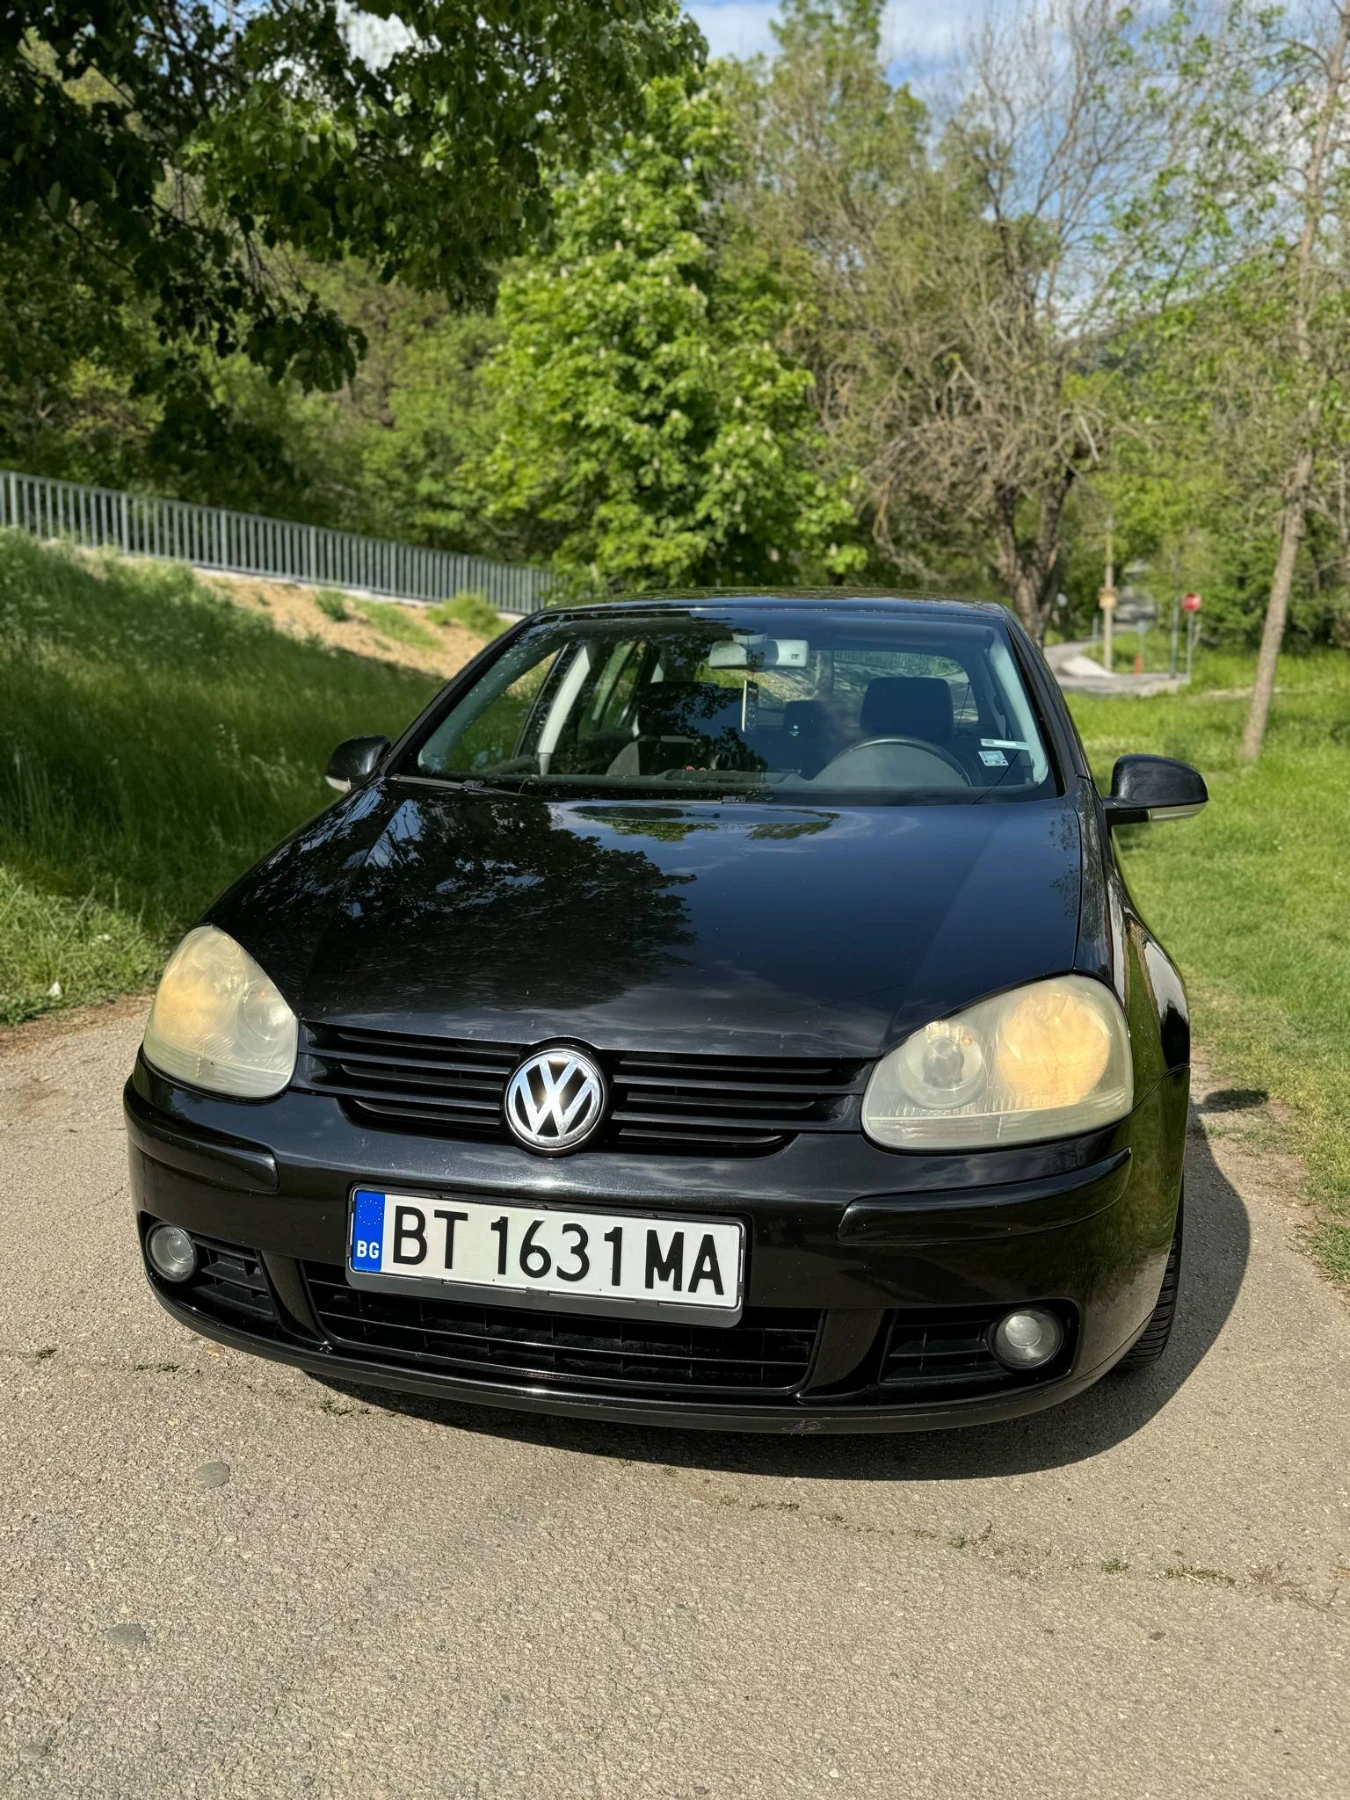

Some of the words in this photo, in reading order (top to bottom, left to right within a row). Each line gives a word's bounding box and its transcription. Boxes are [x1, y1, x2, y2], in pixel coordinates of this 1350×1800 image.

[511, 1053, 599, 1145] VW
[356, 1239, 380, 1260] BG
[392, 1205, 469, 1270] BT
[490, 1215, 624, 1287] 1631
[644, 1229, 725, 1296] MA
